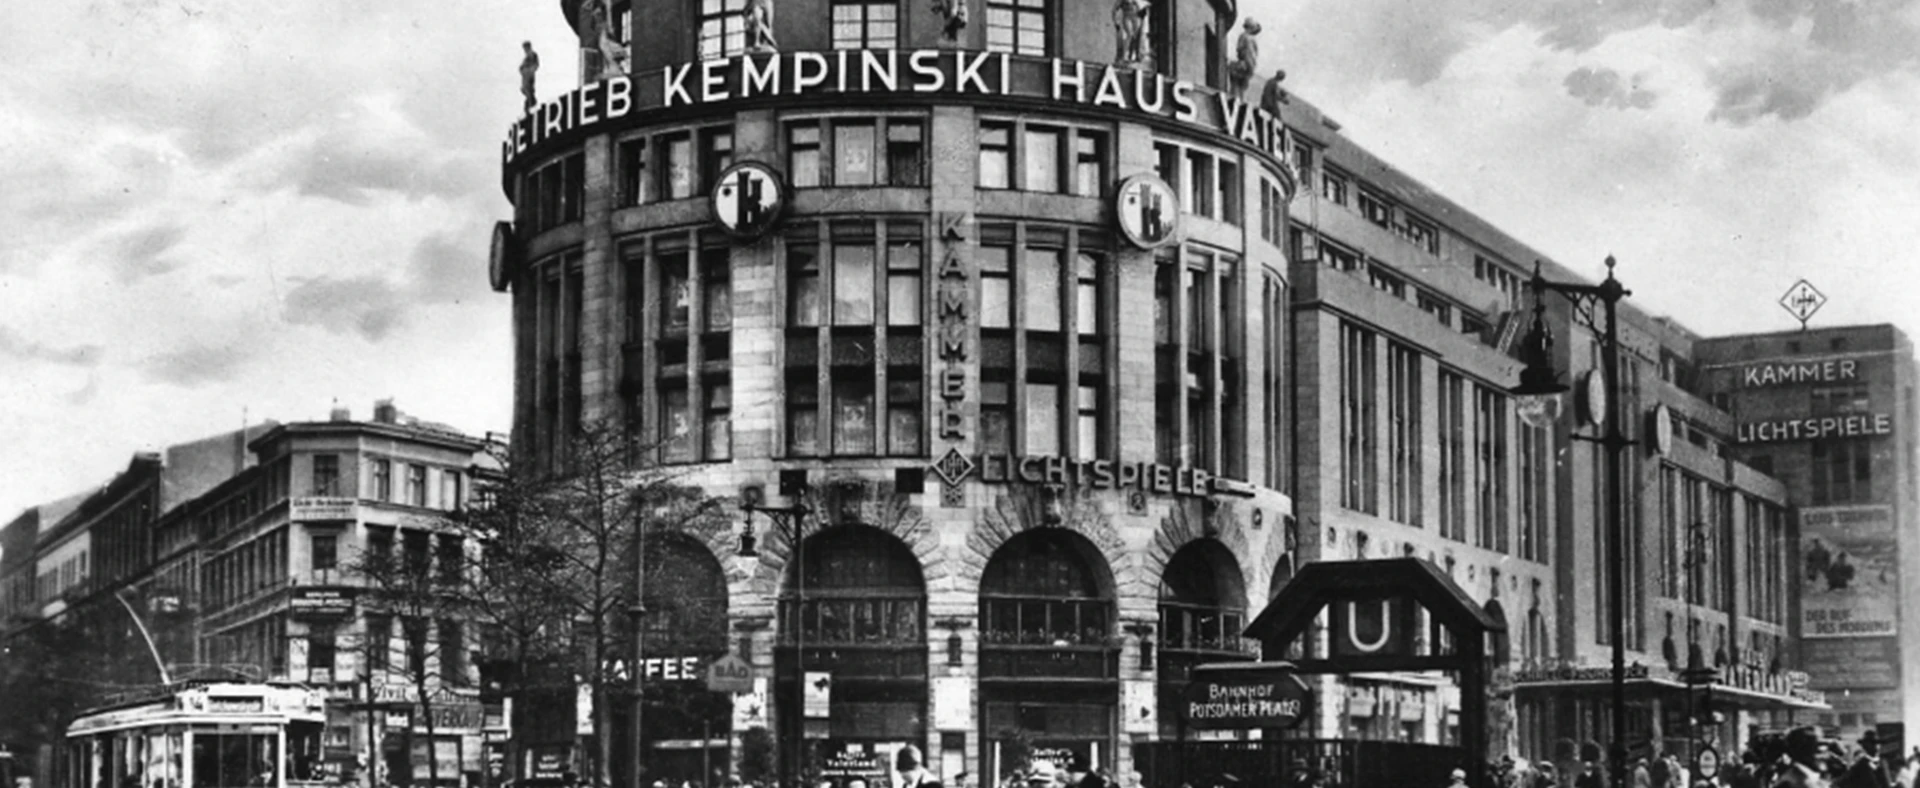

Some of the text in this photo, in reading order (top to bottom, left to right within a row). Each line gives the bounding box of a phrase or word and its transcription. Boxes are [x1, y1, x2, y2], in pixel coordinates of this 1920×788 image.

[506, 76, 632, 164] BETRIEB
[664, 50, 1010, 106] KEMPINSKI
[1053, 57, 1198, 122] HAUS
[938, 212, 968, 440] KAMMER
[1744, 360, 1856, 387] KAMMER
[1737, 413, 1891, 443] LICHTSPIELE
[981, 455, 1209, 496] LICHTSPIELE
[1348, 601, 1390, 651] U
[1208, 683, 1275, 699] BAHNHOF
[1189, 702, 1257, 718] POTSDAMER
